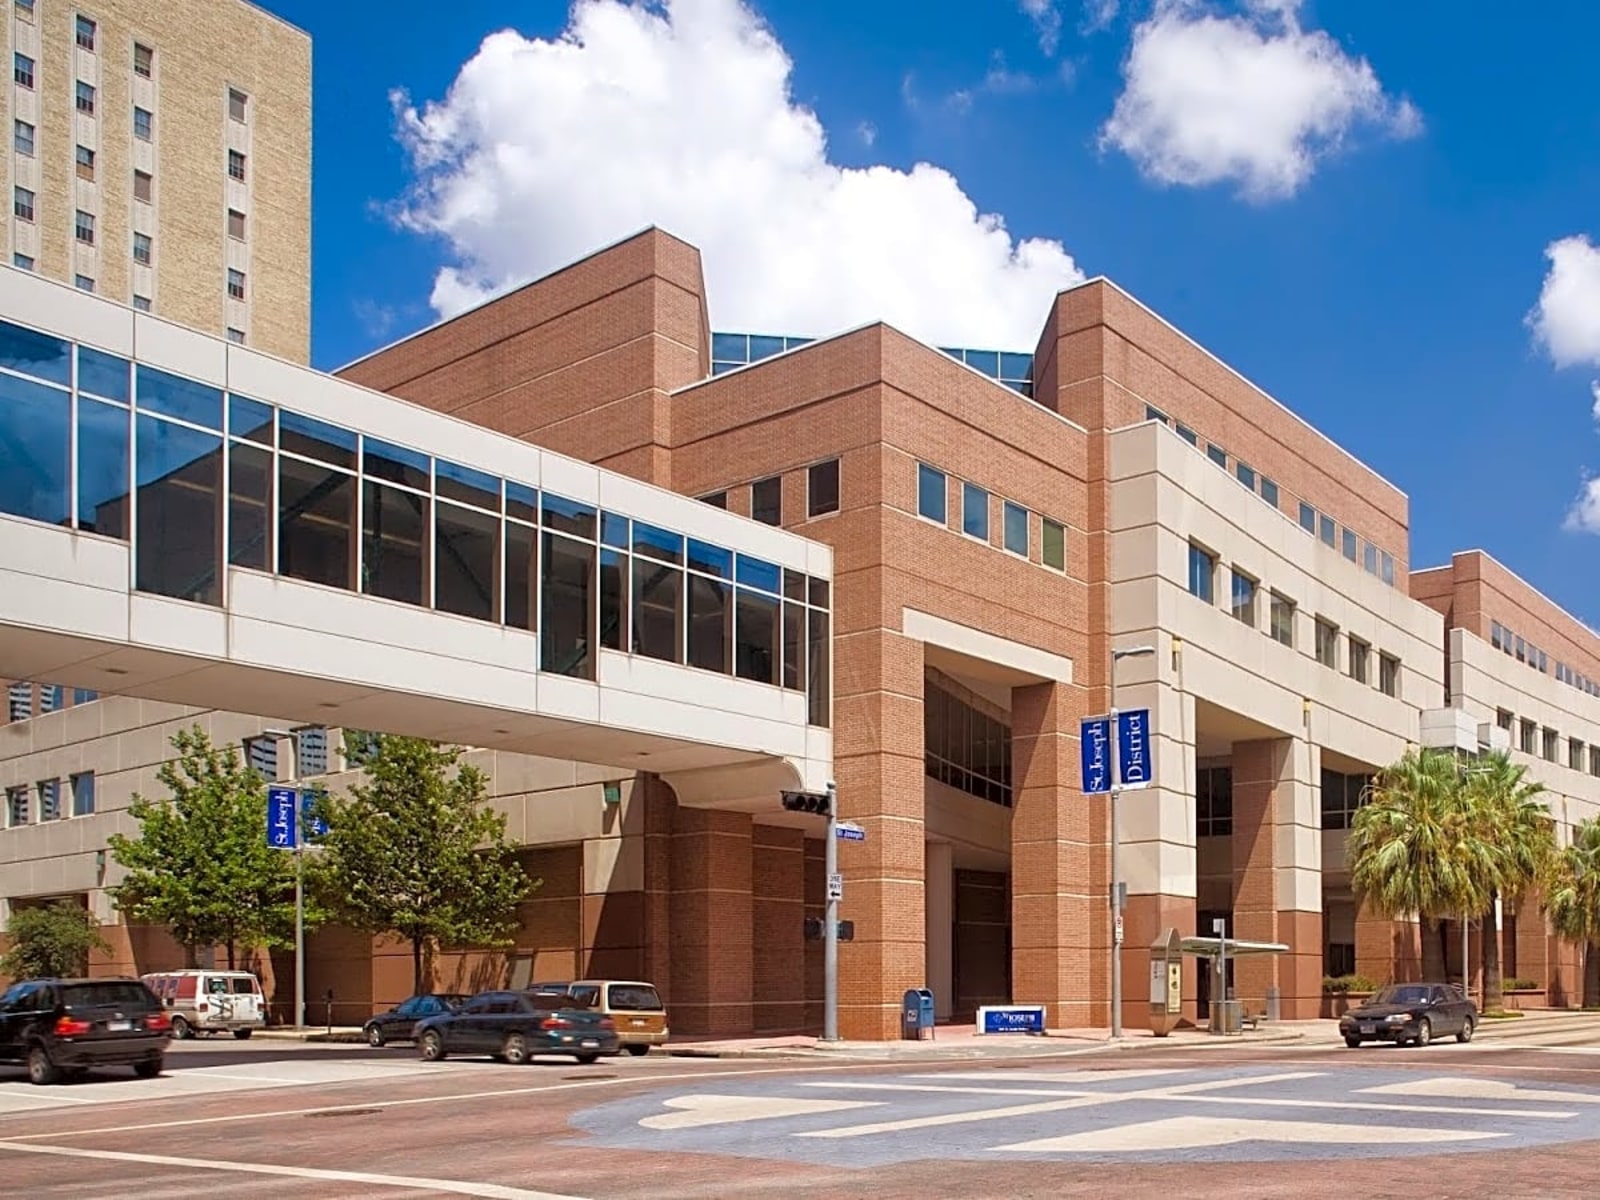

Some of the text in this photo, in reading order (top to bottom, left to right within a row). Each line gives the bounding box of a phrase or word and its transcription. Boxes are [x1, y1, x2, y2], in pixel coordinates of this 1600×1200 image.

[1088, 722, 1107, 771] Joseph
[1126, 713, 1144, 781] District
[274, 791, 292, 831] Joseph
